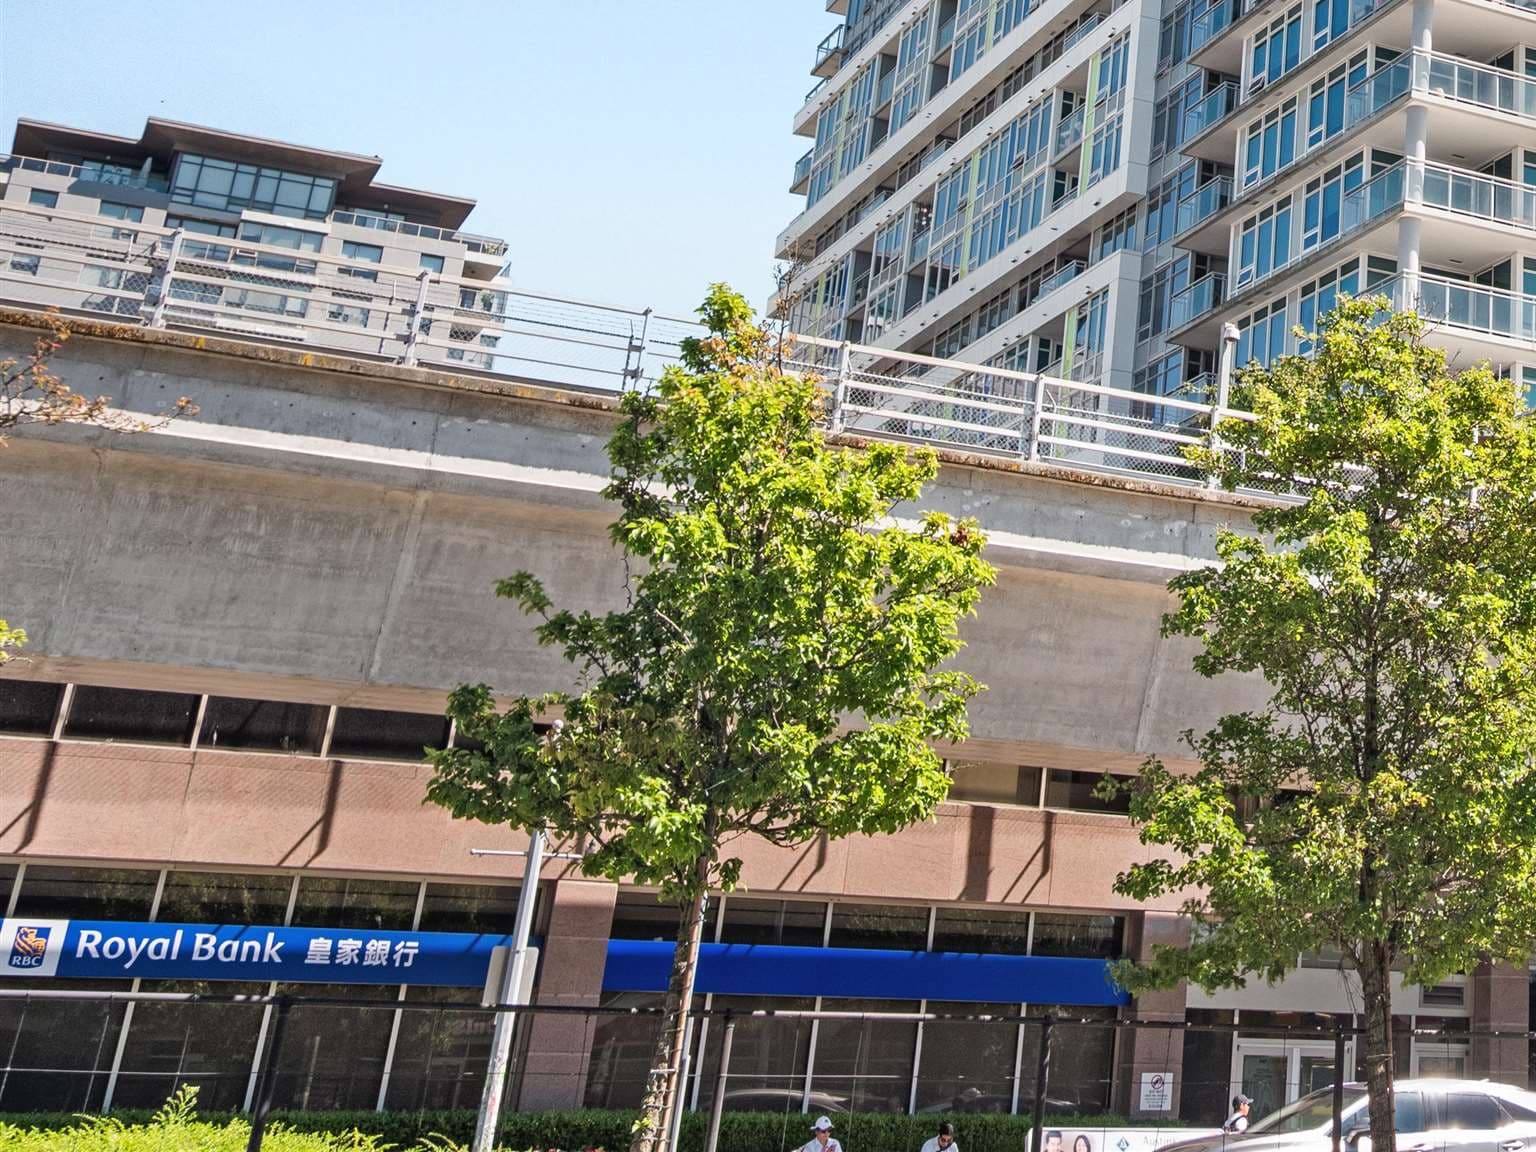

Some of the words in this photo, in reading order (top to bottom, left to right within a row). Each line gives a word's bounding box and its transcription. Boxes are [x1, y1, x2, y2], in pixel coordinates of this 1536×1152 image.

[11, 955, 41, 966] RBC
[75, 929, 184, 969] Royal
[191, 931, 286, 963] Bank
[304, 936, 420, 967] 皇家銀行
